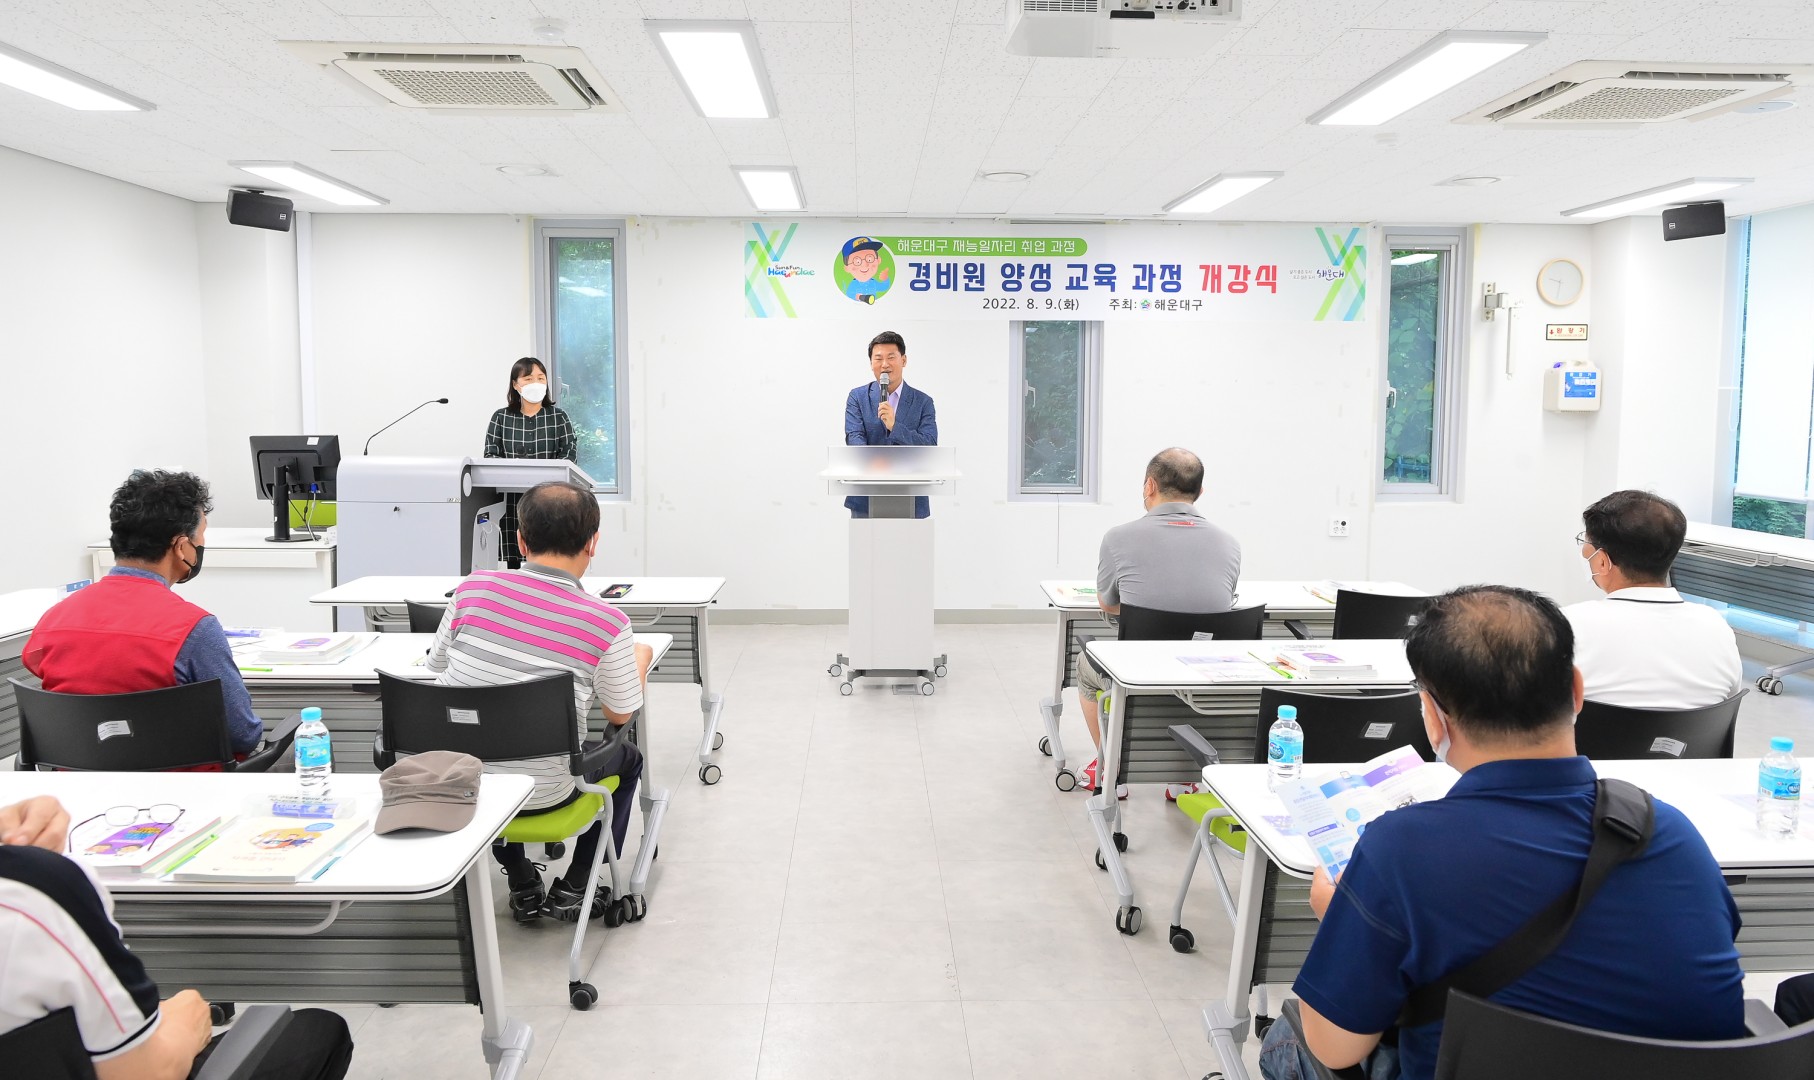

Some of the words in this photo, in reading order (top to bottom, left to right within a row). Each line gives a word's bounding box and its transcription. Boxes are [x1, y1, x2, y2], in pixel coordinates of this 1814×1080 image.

[897, 239, 949, 253] 해운대구
[952, 239, 1016, 253] 재능일자리
[1021, 240, 1046, 253] 취업
[1050, 240, 1075, 254] 과정
[908, 262, 985, 292] 경비원
[1000, 262, 1052, 293] 양성
[1065, 263, 1117, 293] 교육
[1132, 263, 1182, 293] 과정
[1199, 264, 1278, 294] 개강식
[982, 298, 1020, 310] 2022.
[1026, 298, 1039, 310] 8.
[1045, 298, 1080, 311] 9.(화)
[1108, 299, 1137, 311] 주최:
[1154, 299, 1203, 311] 해운대구
